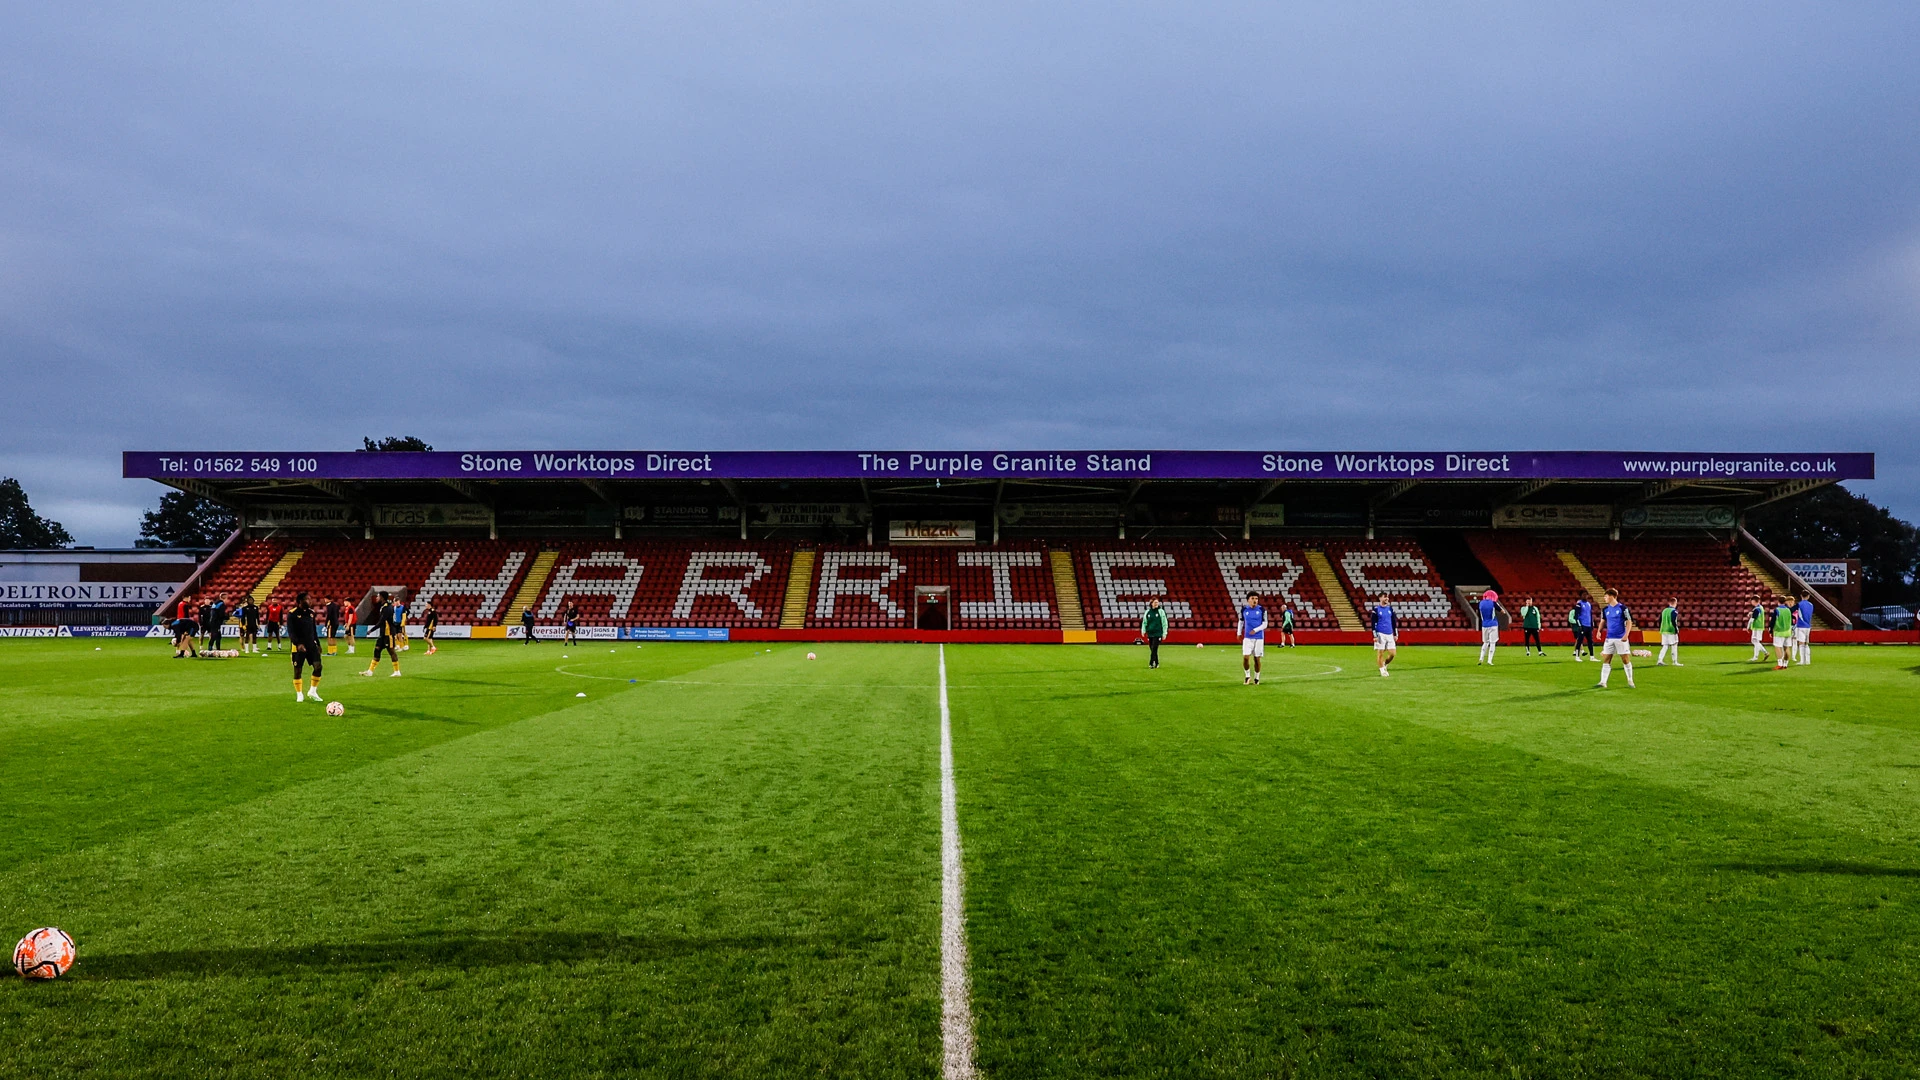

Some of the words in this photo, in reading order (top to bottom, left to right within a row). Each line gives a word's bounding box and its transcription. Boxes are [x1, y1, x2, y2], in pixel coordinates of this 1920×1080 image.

[160, 458, 187, 472] Tel:
[193, 458, 243, 472] 01562
[250, 458, 280, 472] 549
[287, 458, 317, 472] 100
[461, 454, 522, 472] Stone
[534, 454, 635, 475] Worktops
[646, 454, 712, 472] Direct
[858, 454, 899, 471] The
[909, 454, 983, 475] Purple
[992, 454, 1077, 472] Granite
[1086, 454, 1151, 472] Stand
[1262, 455, 1323, 472] Stone
[1335, 455, 1435, 476] Worktops
[1446, 455, 1510, 472] Direct
[1623, 458, 1837, 476] www.purplegranite.co.uk
[379, 505, 425, 524] Tricas
[653, 506, 709, 514] STANDARD
[773, 505, 796, 513] WEST
[800, 505, 841, 513] MIDLAND
[1521, 507, 1558, 518] CMS
[779, 514, 809, 522] SAFARI
[905, 521, 959, 537] Mazak
[98, 585, 159, 599] LIFTS
[407, 551, 1452, 620] HARRIERS
[13, 628, 46, 636] LIFTS
